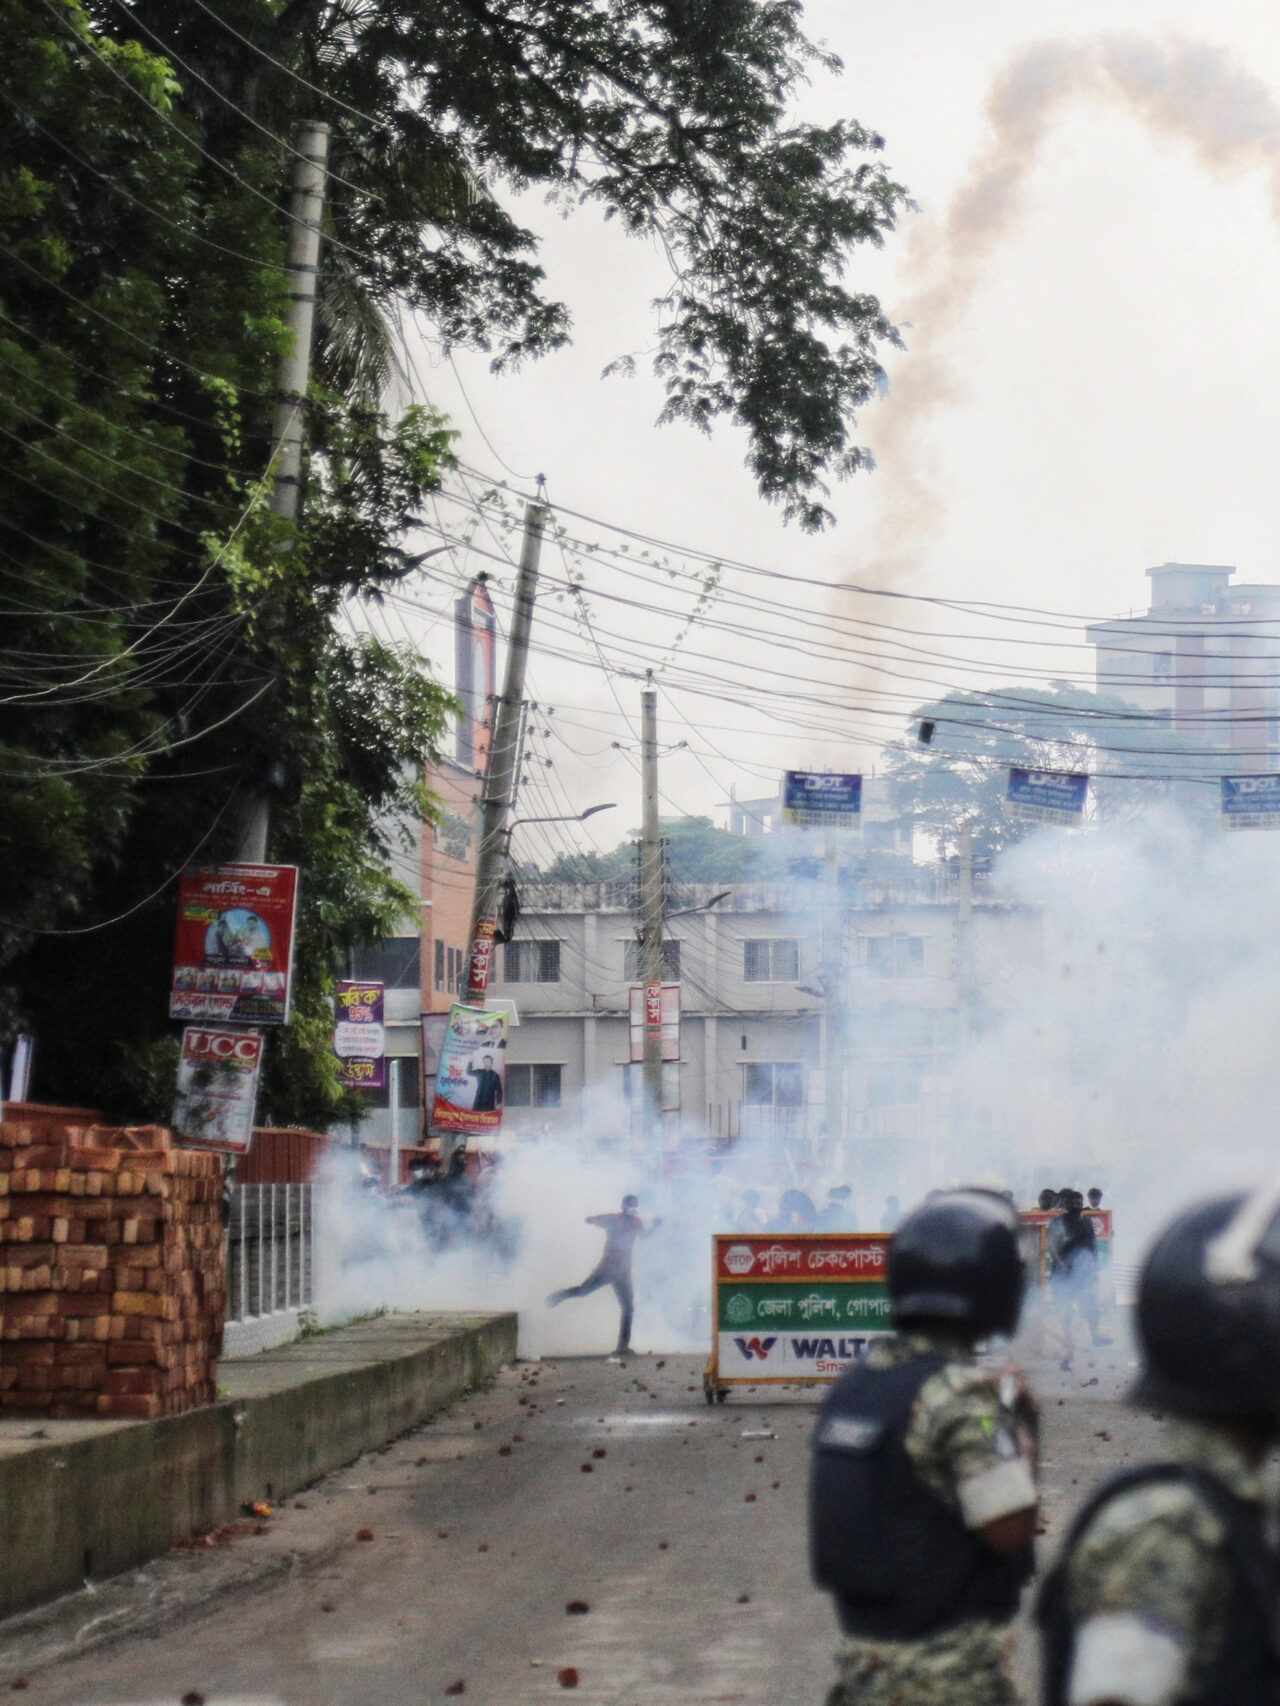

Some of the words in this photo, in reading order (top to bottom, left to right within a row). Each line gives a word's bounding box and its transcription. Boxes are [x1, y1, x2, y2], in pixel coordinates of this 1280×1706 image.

[348, 1006, 373, 1022] 95%
[187, 1032, 258, 1060] UCC
[726, 1254, 753, 1267] STOP
[757, 1245, 801, 1273] পুলিশ
[807, 1245, 885, 1269] চেকপোস্ট
[757, 1299, 793, 1317] জেলা
[797, 1294, 841, 1321] পুলিশ,
[815, 1361, 848, 1373] Sma
